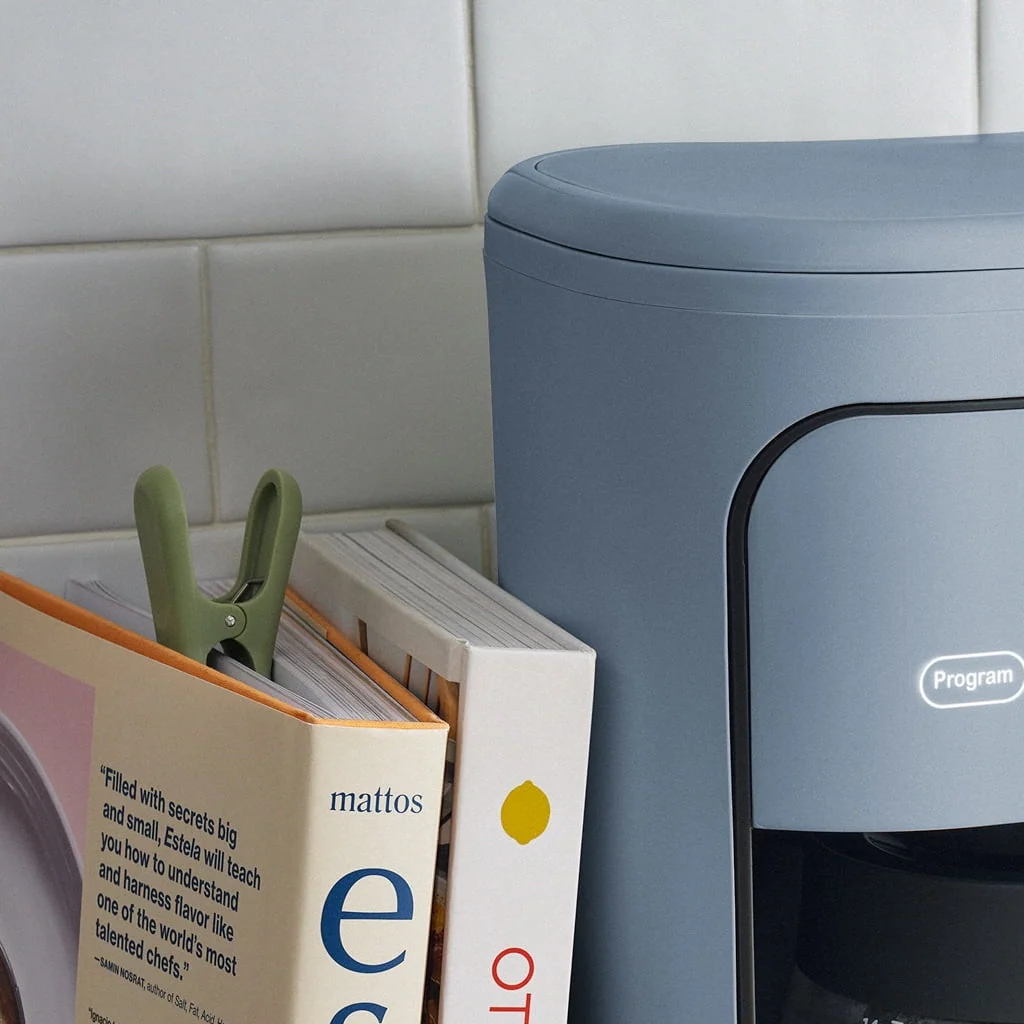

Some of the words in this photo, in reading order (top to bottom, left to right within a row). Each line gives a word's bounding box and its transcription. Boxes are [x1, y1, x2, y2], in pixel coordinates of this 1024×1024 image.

[933, 666, 1013, 691] Program
[101, 765, 137, 800] “Filled
[140, 787, 165, 813] with
[168, 802, 214, 835] secrets
[218, 818, 237, 850] big
[329, 786, 424, 815] mattos
[101, 832, 122, 856] you
[125, 838, 150, 868] how
[153, 853, 165, 875] to
[168, 864, 239, 912] understand
[103, 803, 124, 826] and
[127, 814, 161, 846] small,
[164, 826, 200, 861] Estela
[204, 849, 224, 872] will
[228, 856, 260, 890] teach
[97, 893, 118, 916] one
[122, 904, 134, 923] of
[137, 908, 156, 934] the
[160, 924, 202, 958] world’s
[206, 947, 236, 976] most
[99, 863, 120, 886] and
[124, 869, 171, 910] harness
[175, 895, 209, 928] flavor
[212, 912, 234, 941] like
[96, 918, 144, 960] talented
[147, 947, 189, 980] chefs.”
[94, 957, 119, 975] —SAMIN
[120, 968, 145, 990] NOSRAT,
[147, 983, 166, 999] author
[174, 995, 187, 1012] Salt,
[189, 1002, 199, 1020] Fat,
